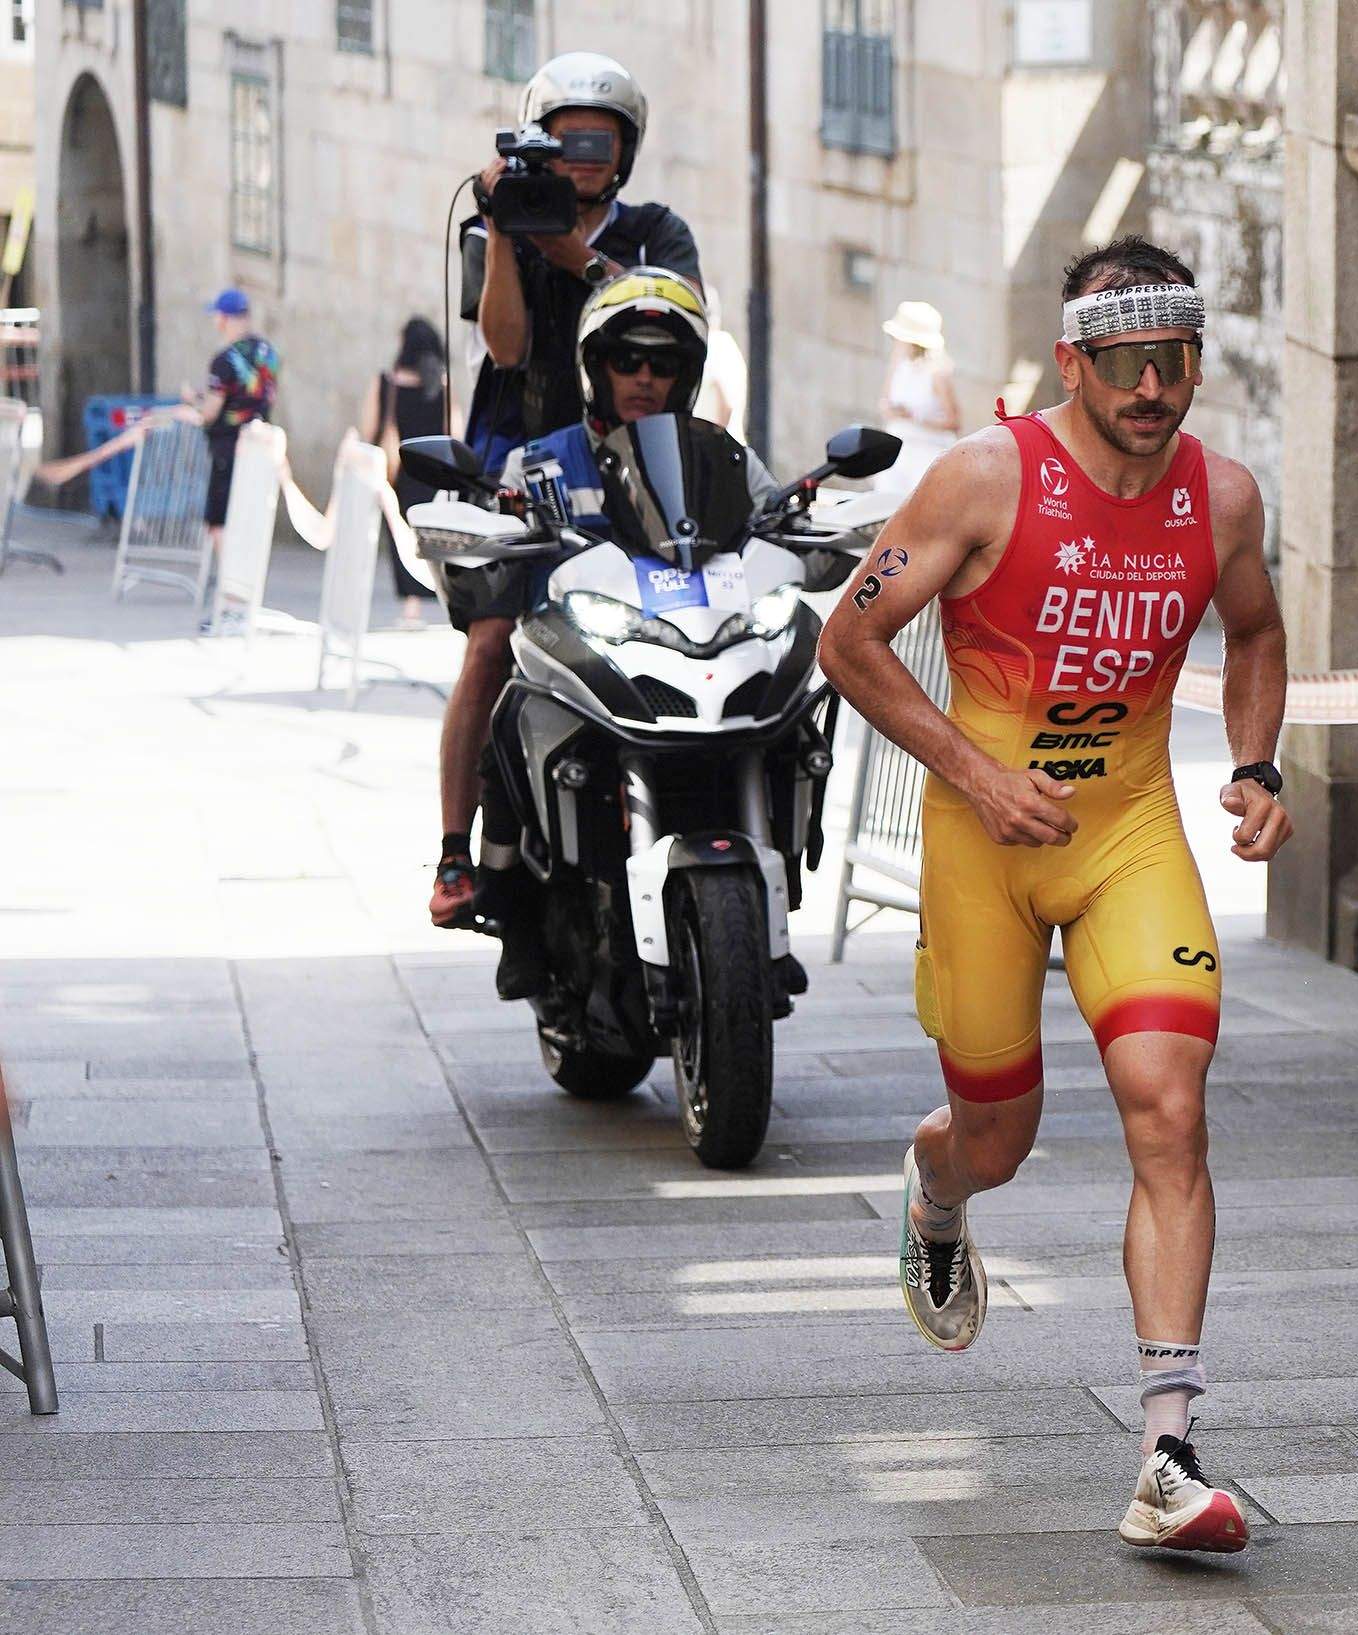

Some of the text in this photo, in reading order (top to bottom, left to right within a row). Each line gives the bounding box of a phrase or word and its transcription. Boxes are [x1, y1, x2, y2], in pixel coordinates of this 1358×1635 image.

[1043, 496, 1068, 510] World
[1038, 504, 1073, 521] Triathlon
[1092, 553, 1111, 568] LA
[1090, 570, 1187, 581] CIUDAD DEL DEPORTE
[852, 574, 882, 612] 2
[1035, 586, 1185, 639] BENITO
[1048, 645, 1154, 692] ESP
[1030, 731, 1120, 750] BMC
